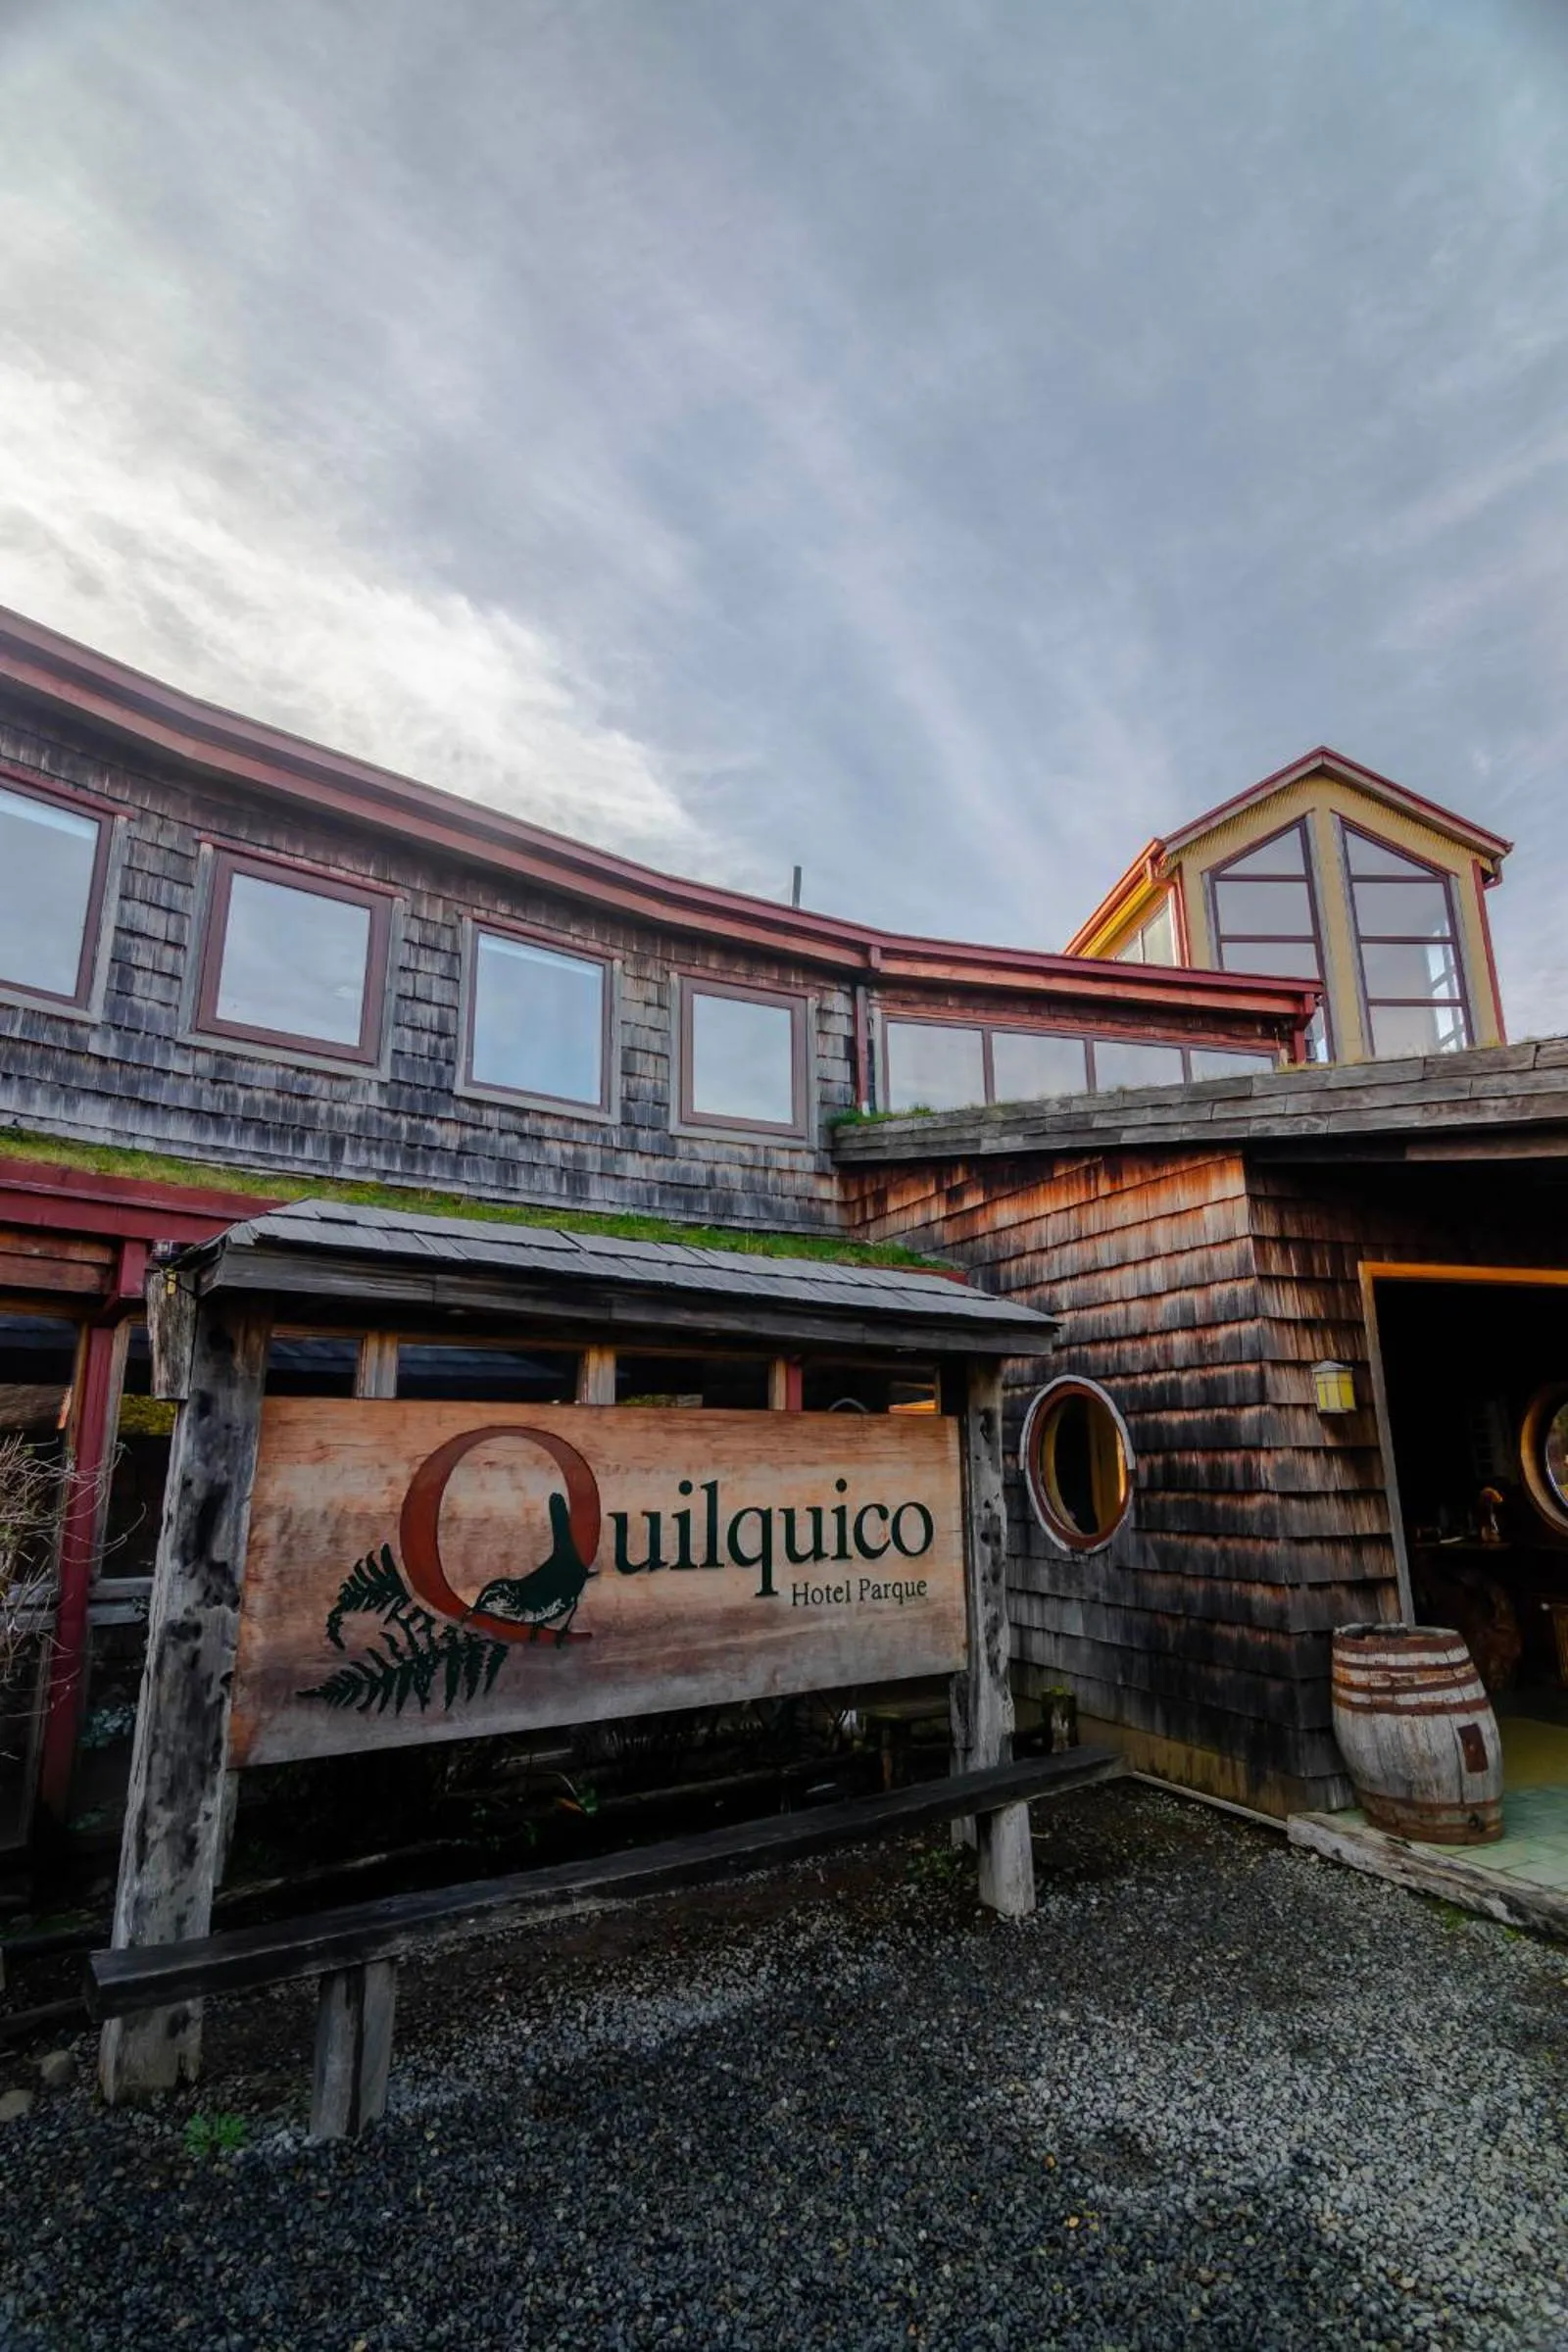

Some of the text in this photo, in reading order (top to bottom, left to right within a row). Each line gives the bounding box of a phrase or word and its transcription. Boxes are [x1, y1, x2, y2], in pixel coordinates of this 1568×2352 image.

[401, 1425, 934, 1643] Quilquico
[791, 1578, 928, 1607] Hotel Parque
